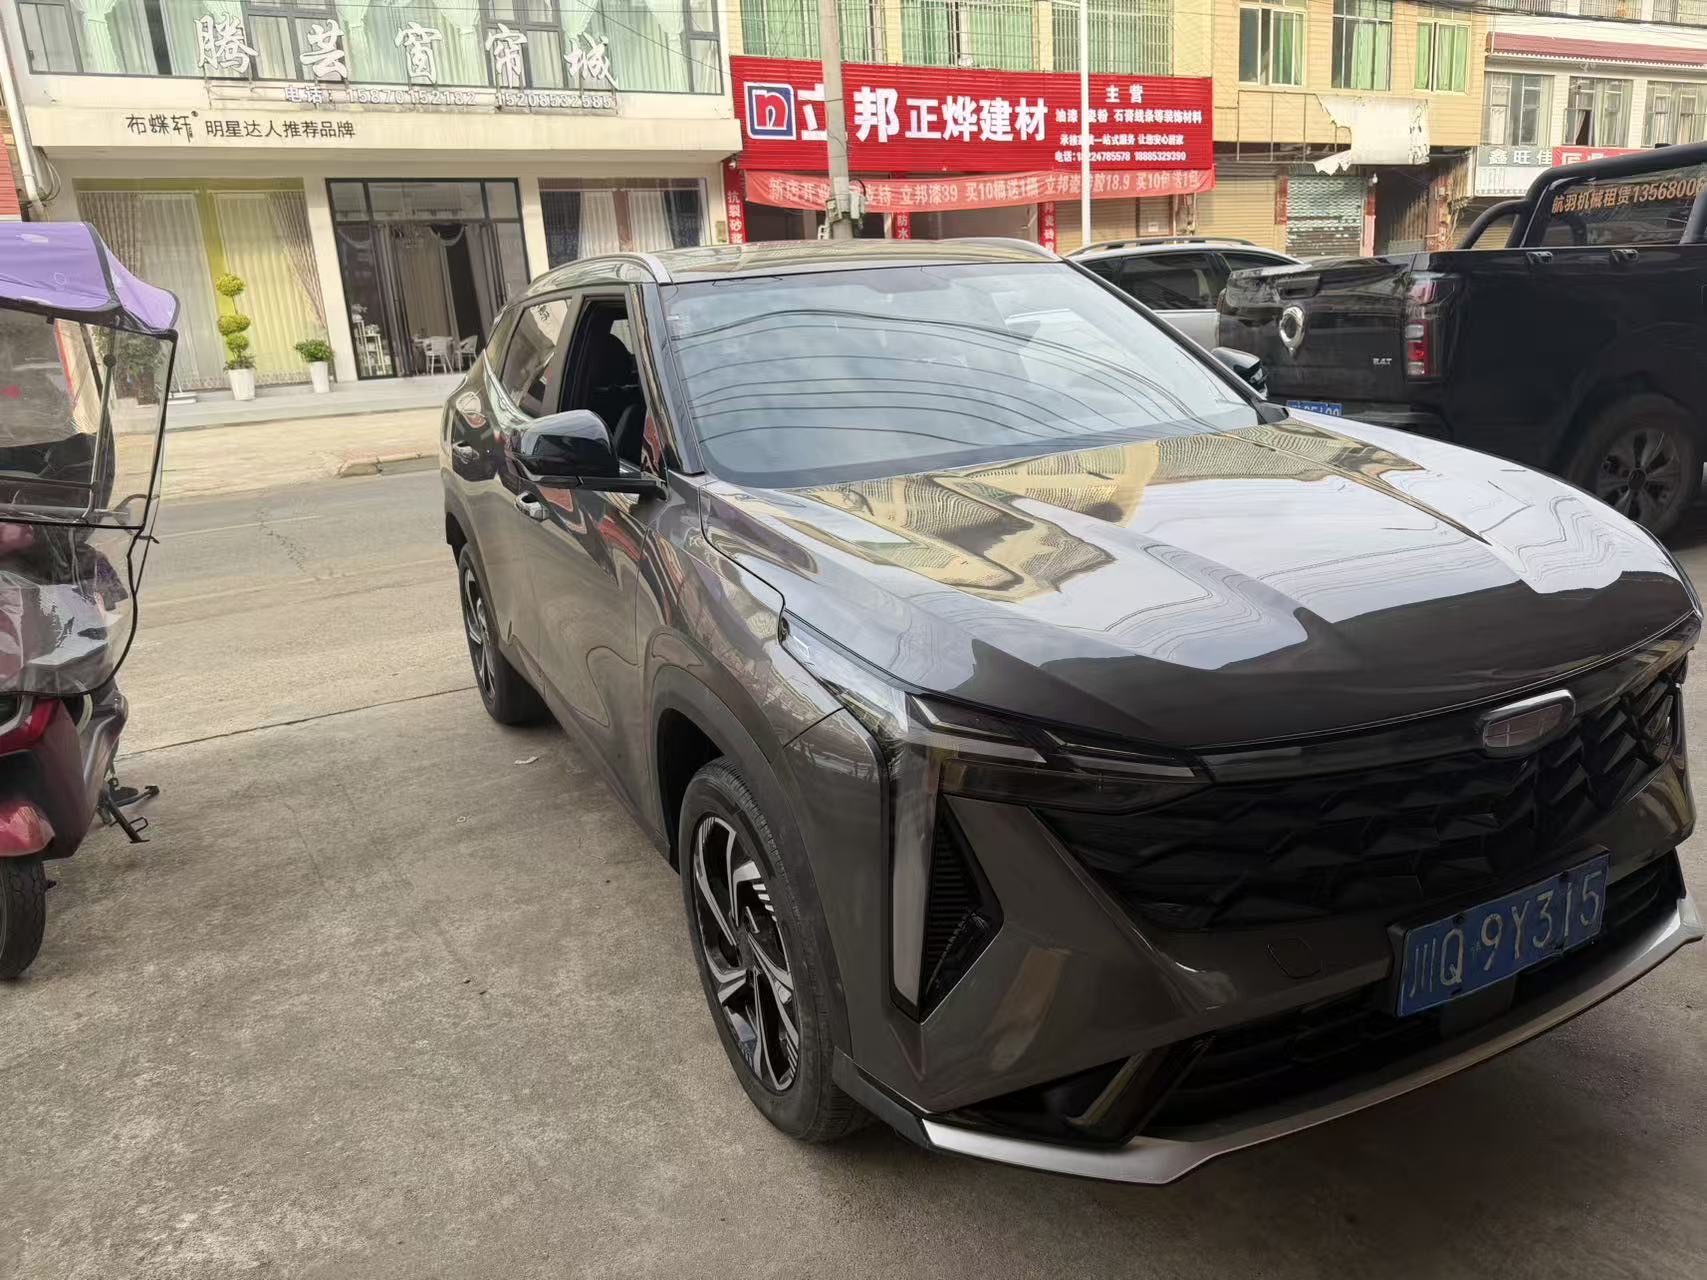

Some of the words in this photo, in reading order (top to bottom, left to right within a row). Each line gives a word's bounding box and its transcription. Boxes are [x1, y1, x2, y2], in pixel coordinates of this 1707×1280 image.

[1105, 84, 1144, 104] 主营
[206, 120, 355, 139] 明星达人推荐品牌
[1060, 134, 1136, 146] 承接一站式服务
[1044, 174, 1131, 195] 立邦瓷胶18.9
